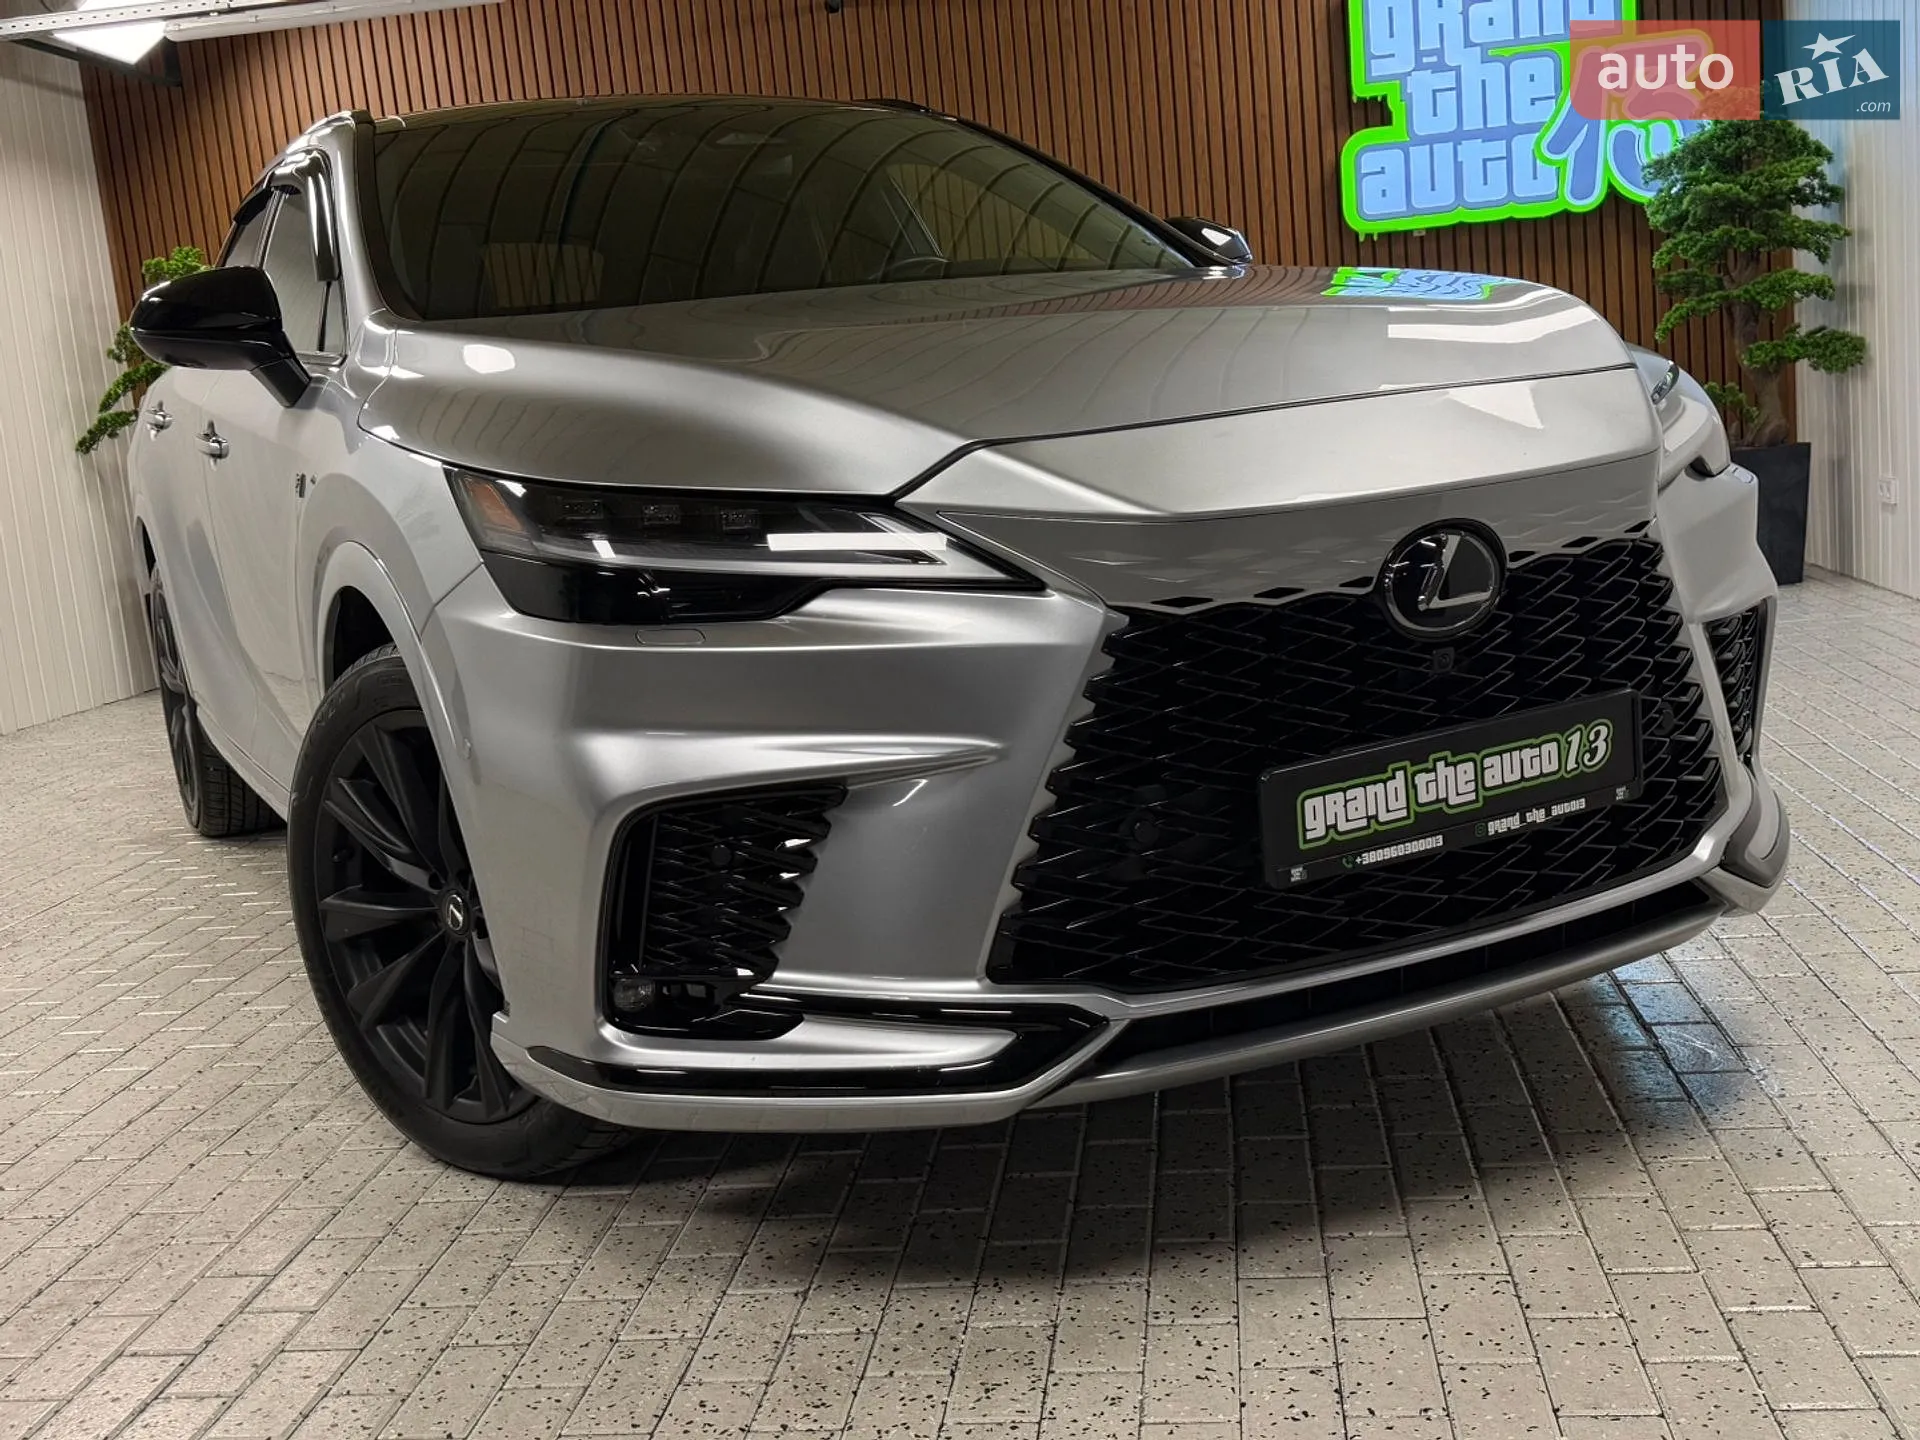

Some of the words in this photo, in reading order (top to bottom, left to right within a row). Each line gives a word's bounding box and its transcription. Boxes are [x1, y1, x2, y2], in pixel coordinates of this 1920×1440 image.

[1407, 47, 1556, 136] the
[1360, 138, 1558, 215] auto
[1414, 760, 1477, 806] the
[1483, 741, 1559, 788] auto
[1566, 725, 1609, 772] 13
